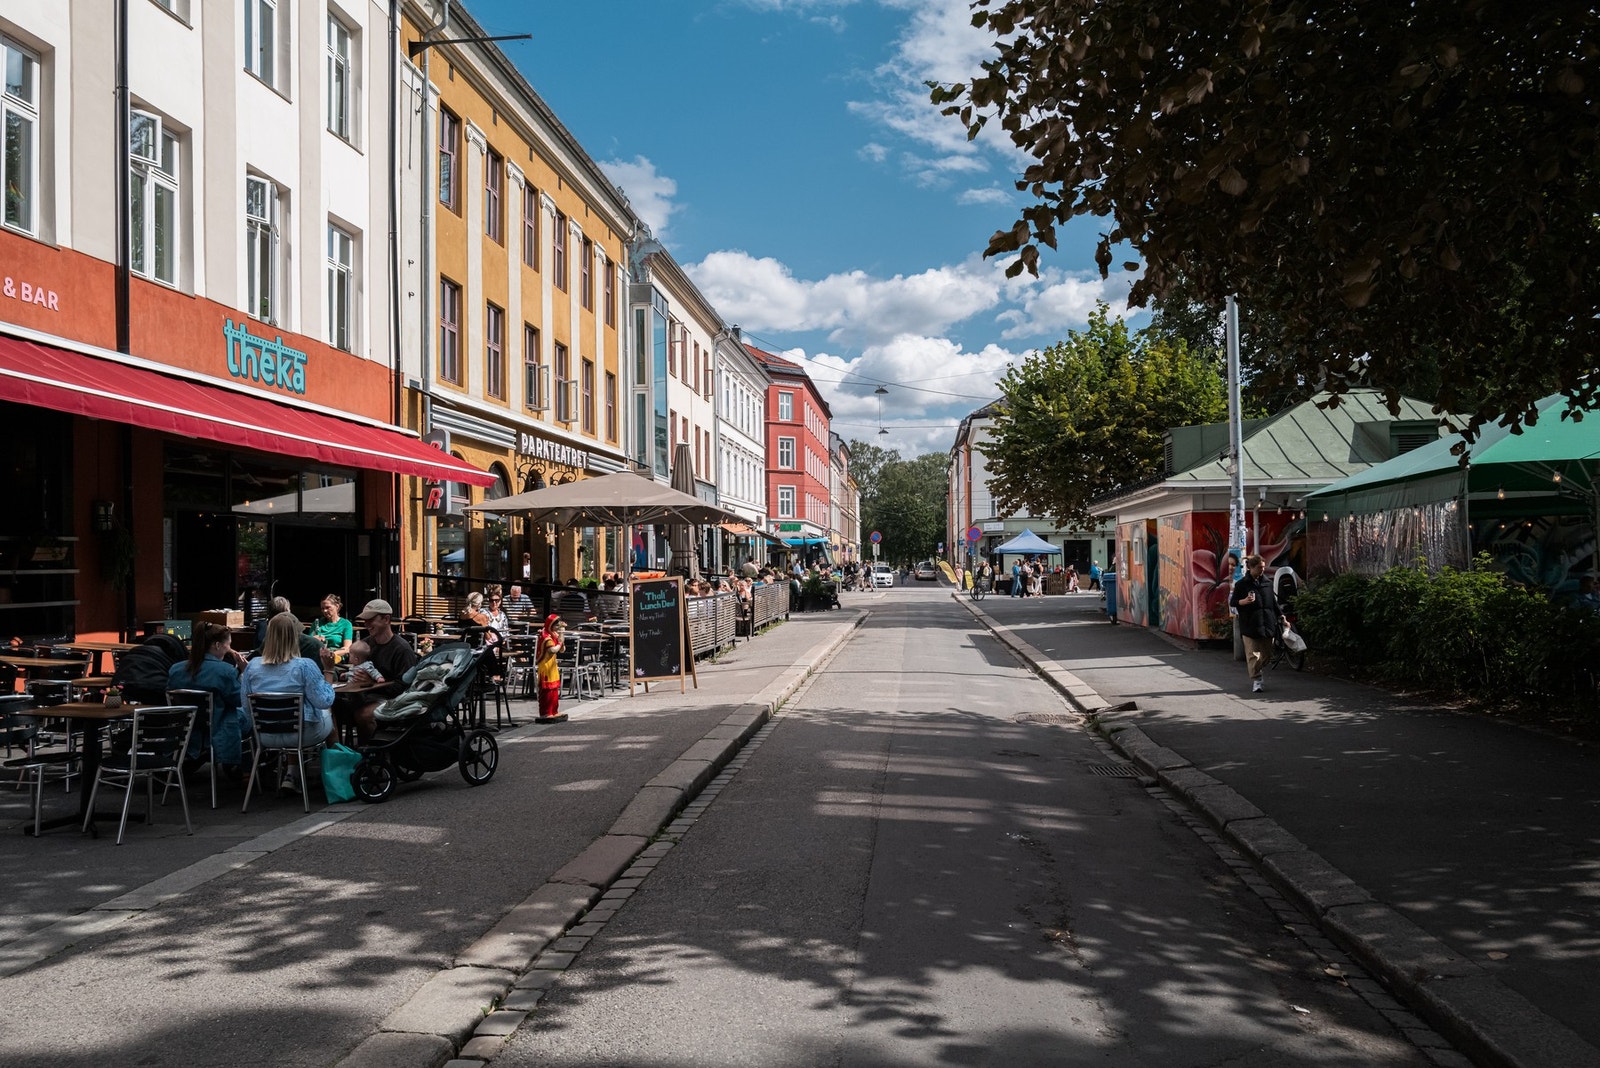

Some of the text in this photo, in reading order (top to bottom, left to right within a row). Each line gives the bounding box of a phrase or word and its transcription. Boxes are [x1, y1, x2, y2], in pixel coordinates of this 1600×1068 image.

[3, 276, 60, 312] & BAR
[223, 318, 308, 395] theka
[520, 432, 587, 469] PARKTEATRET
[639, 598, 676, 611] Lunch Deal
